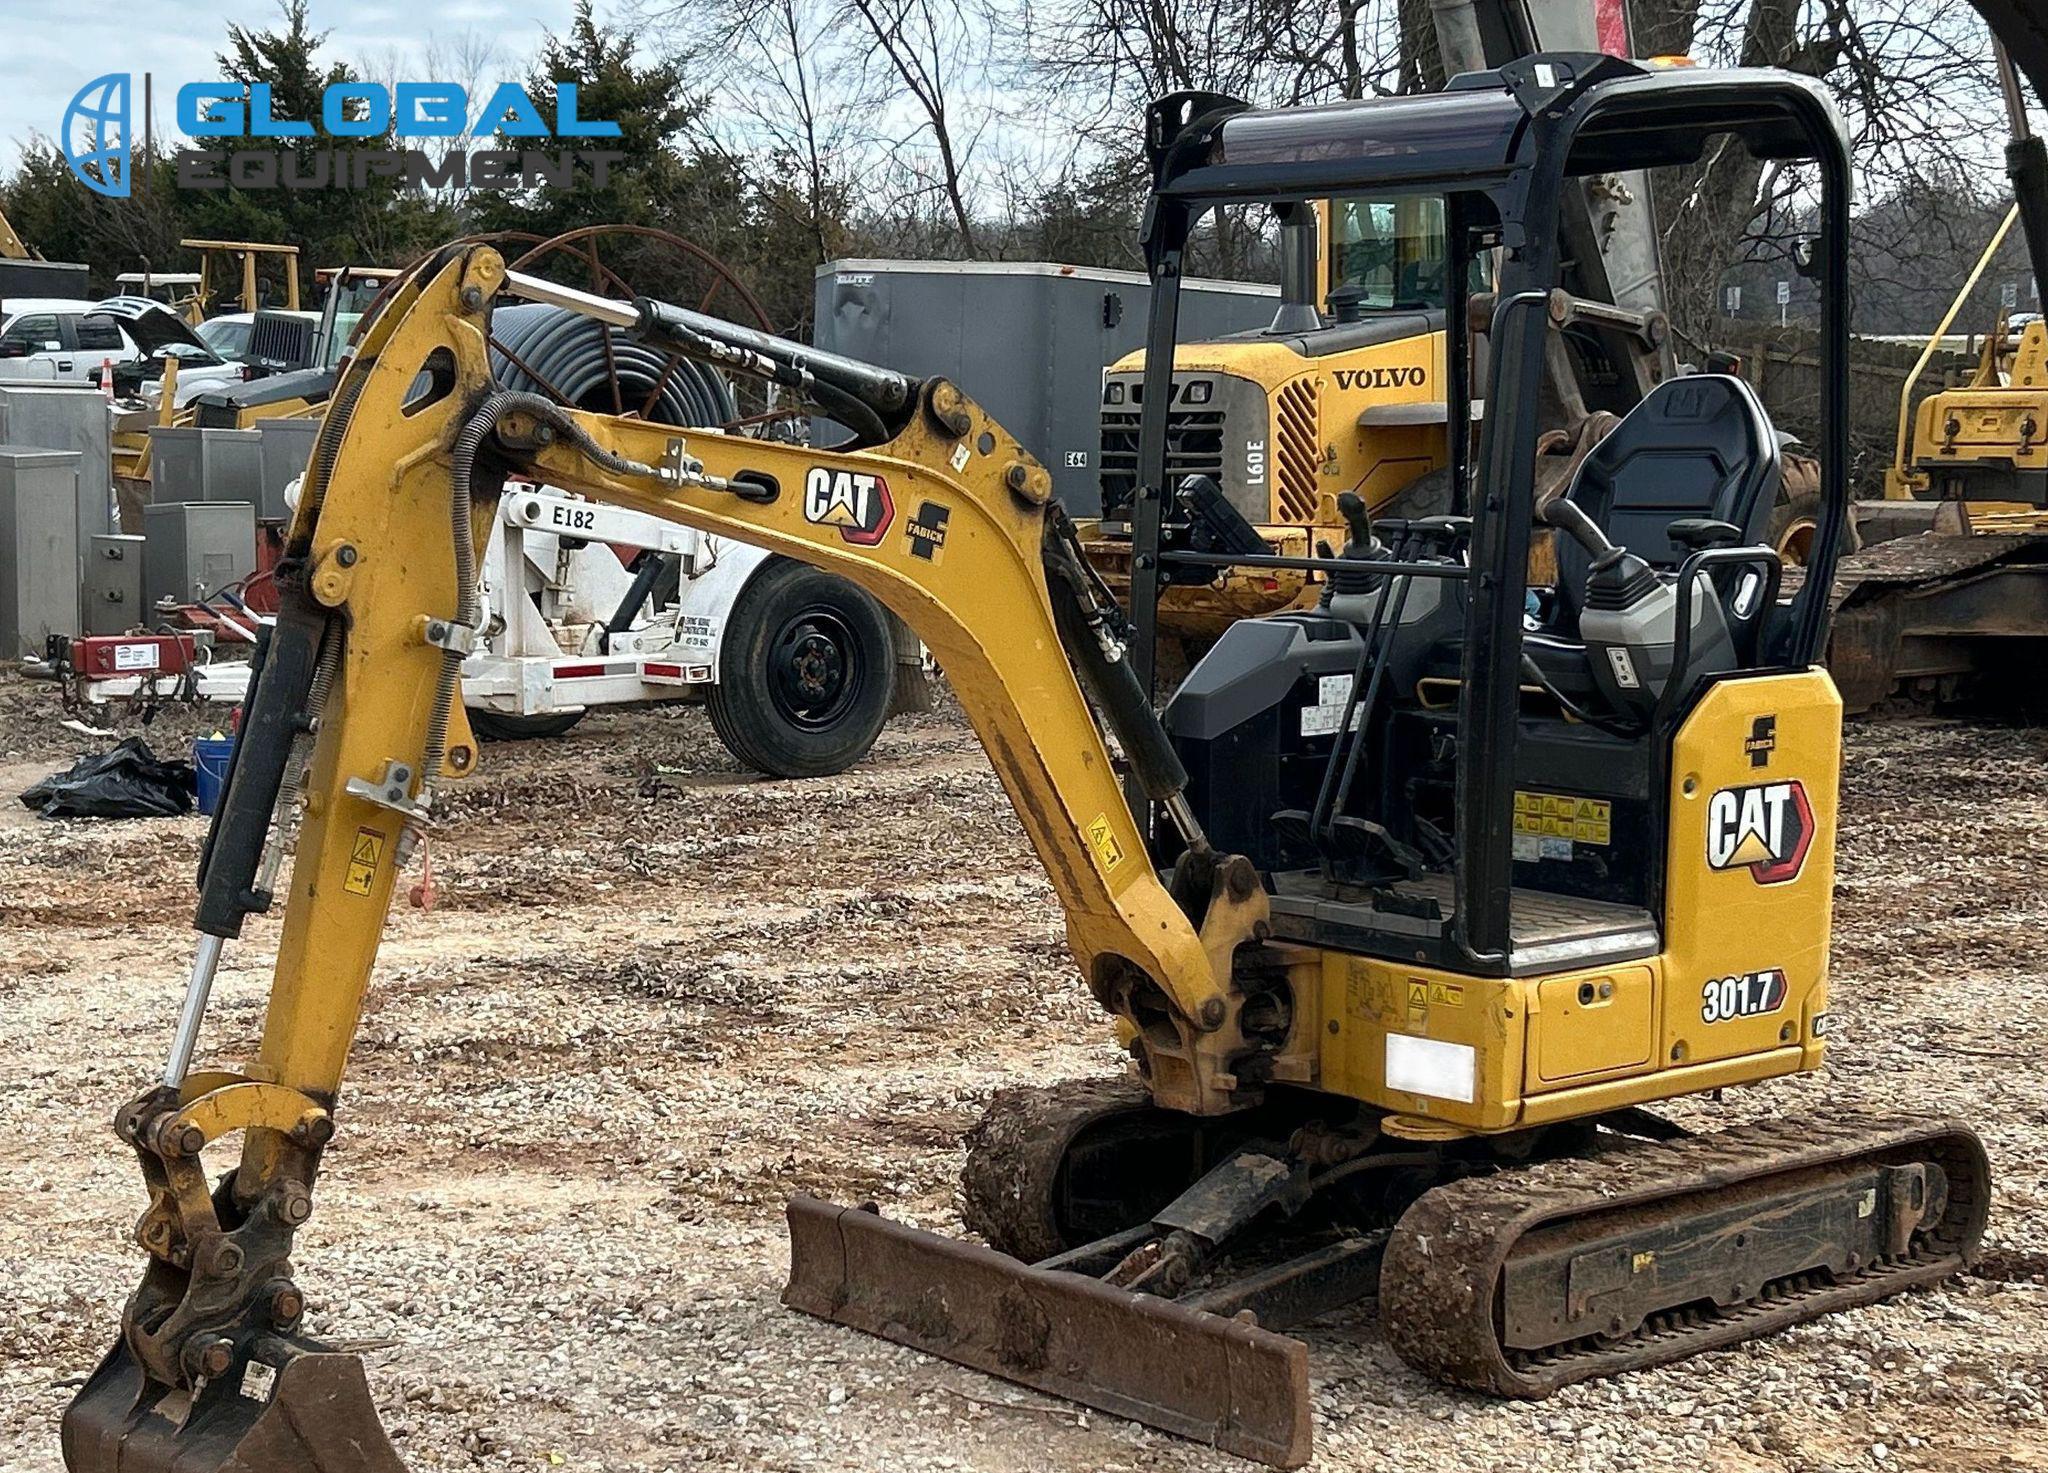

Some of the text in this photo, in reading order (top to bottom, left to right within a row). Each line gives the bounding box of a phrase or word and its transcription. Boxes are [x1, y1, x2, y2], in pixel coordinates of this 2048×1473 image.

[1332, 366, 1426, 391] VOLVO
[1066, 452, 1086, 466] E64
[1247, 440, 1264, 485] L60E
[804, 467, 876, 529] CAT
[553, 505, 595, 530] E182
[907, 522, 944, 543] FABICK
[1709, 784, 1791, 868] CAT
[1702, 972, 1774, 1022] 301.7
